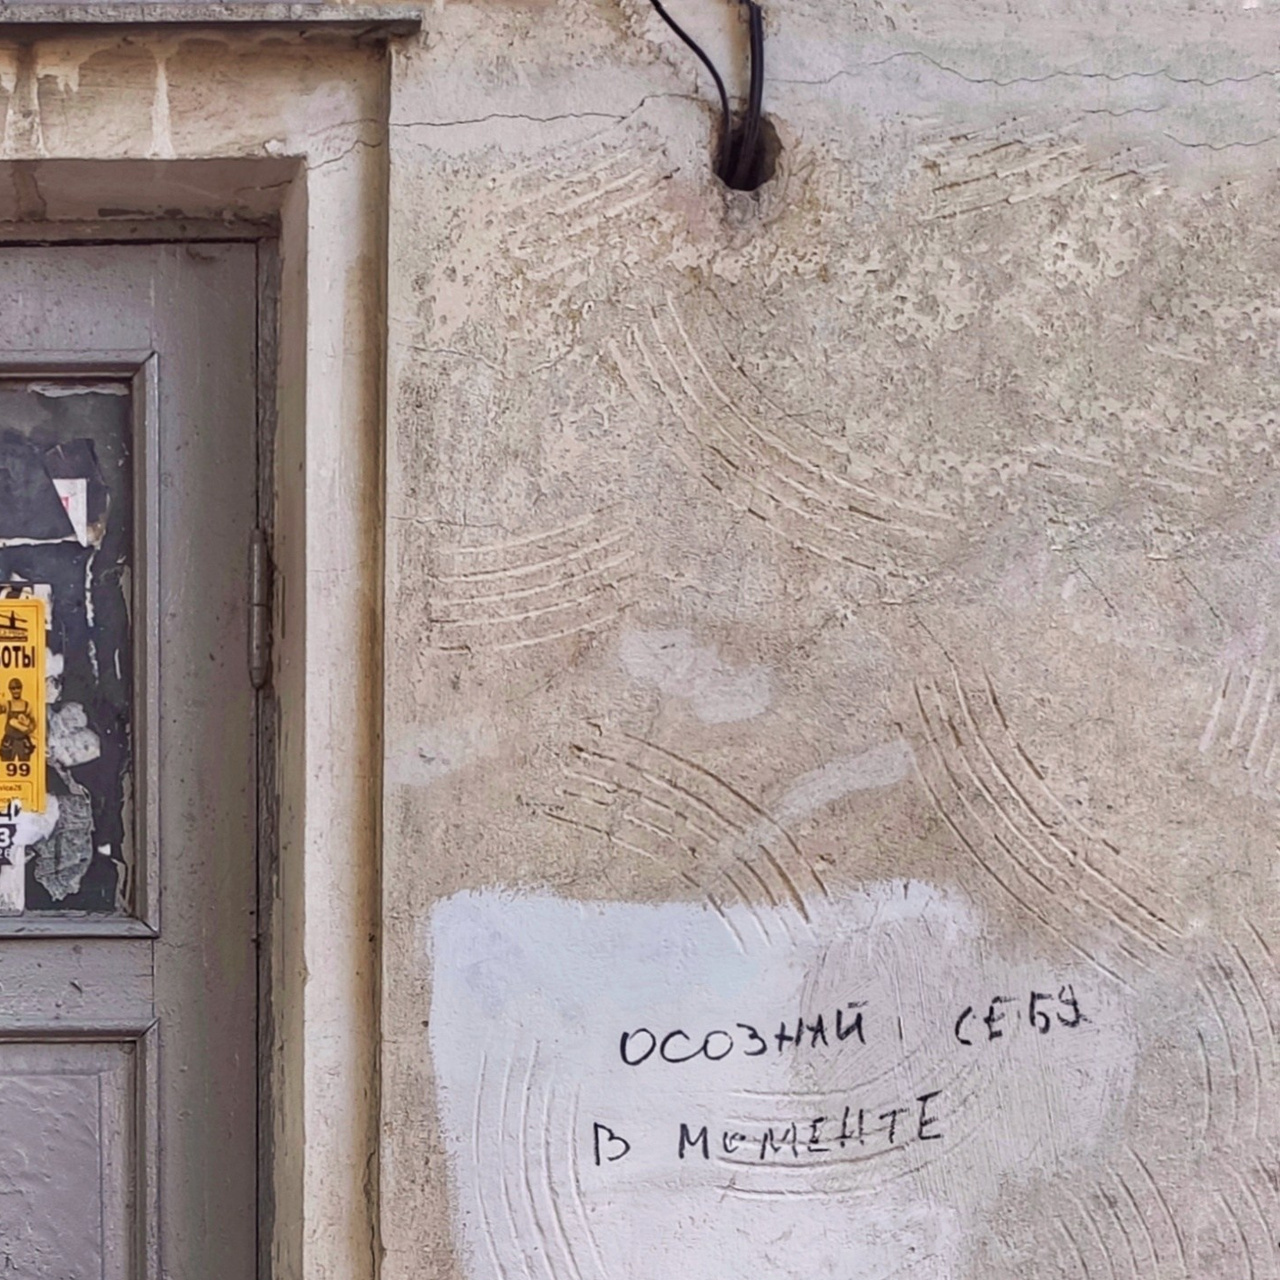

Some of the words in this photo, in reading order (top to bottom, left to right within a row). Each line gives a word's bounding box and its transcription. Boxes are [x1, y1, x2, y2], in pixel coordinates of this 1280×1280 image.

[5, 762, 31, 778] 99
[620, 1000, 870, 1065] ОСОЗНАЙ
[677, 1089, 944, 1161] МОМЕНТЕ
